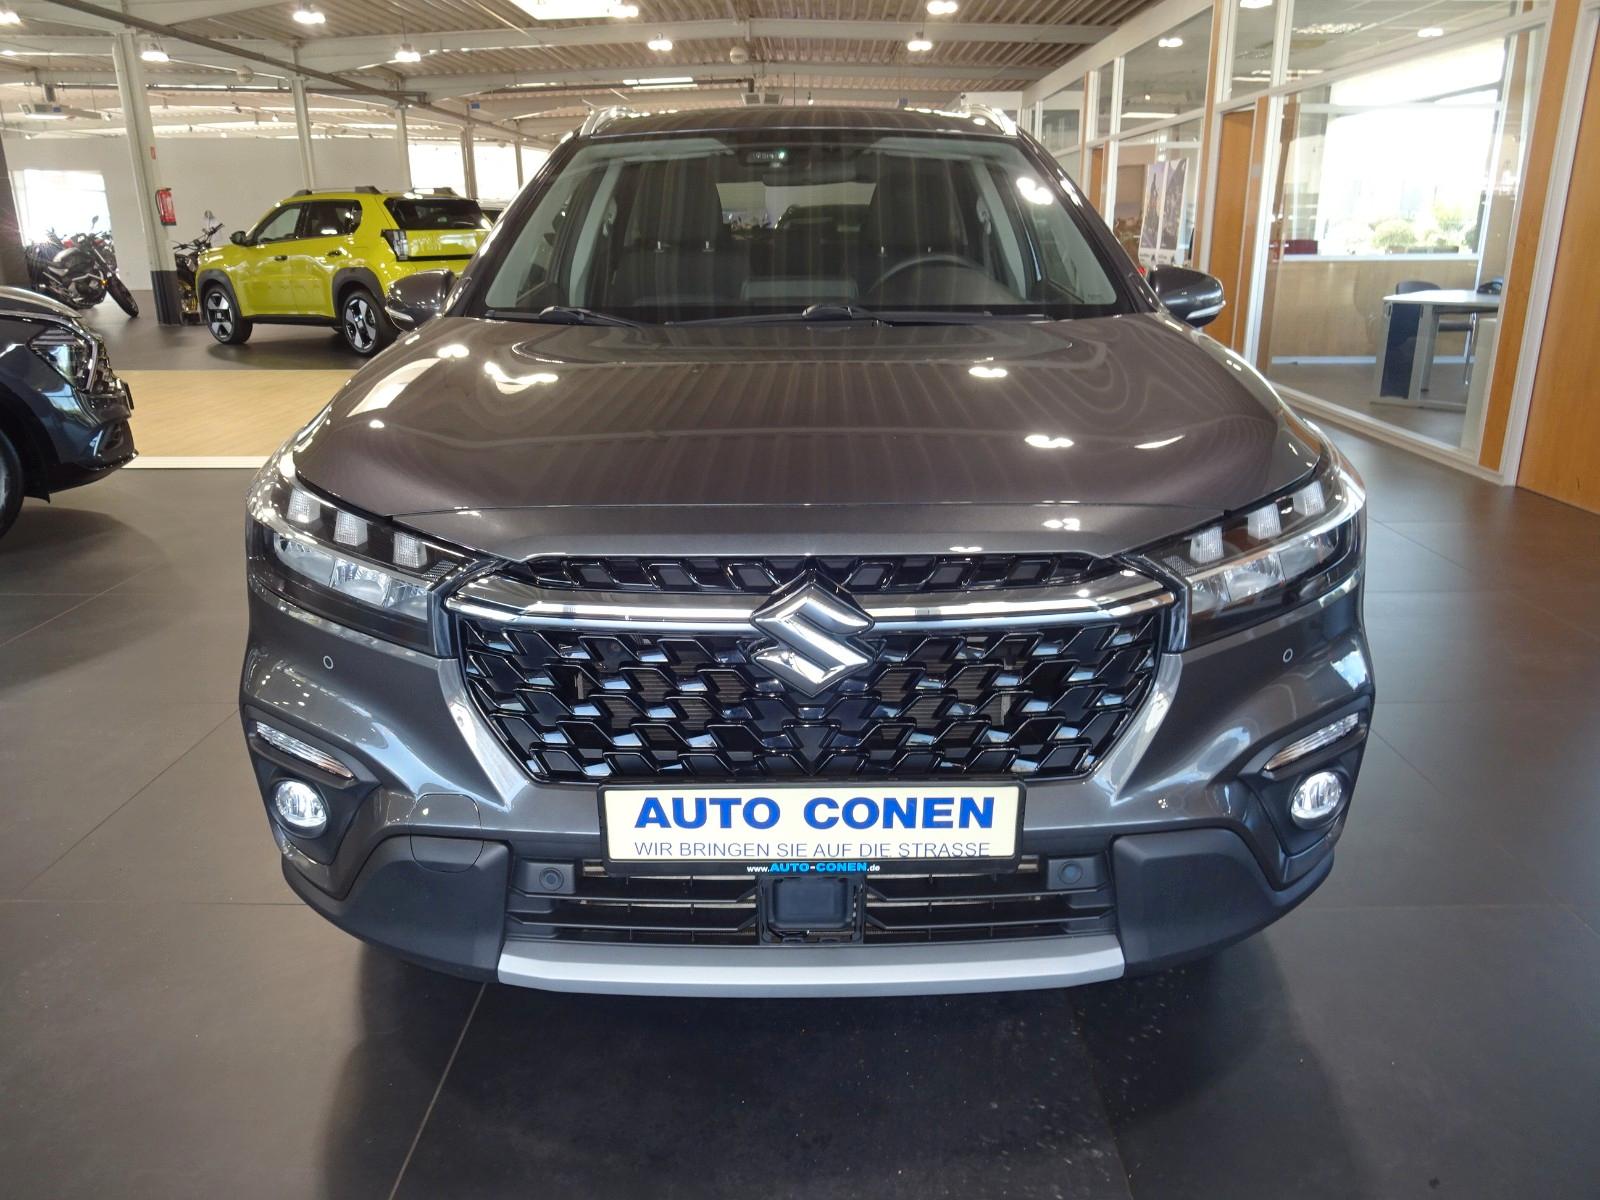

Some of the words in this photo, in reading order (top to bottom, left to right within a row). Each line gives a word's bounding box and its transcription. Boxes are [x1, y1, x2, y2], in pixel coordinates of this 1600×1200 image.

[634, 797, 781, 829] AUTO
[803, 796, 995, 829] CONEN
[634, 841, 673, 857] WIR
[679, 842, 770, 858] BRINGEN
[776, 842, 808, 858] SIE
[813, 842, 853, 858] AUF
[859, 842, 892, 858] DIE
[898, 841, 991, 858] STRASSE
[746, 862, 881, 873] www.AUTO-CONEN.de
